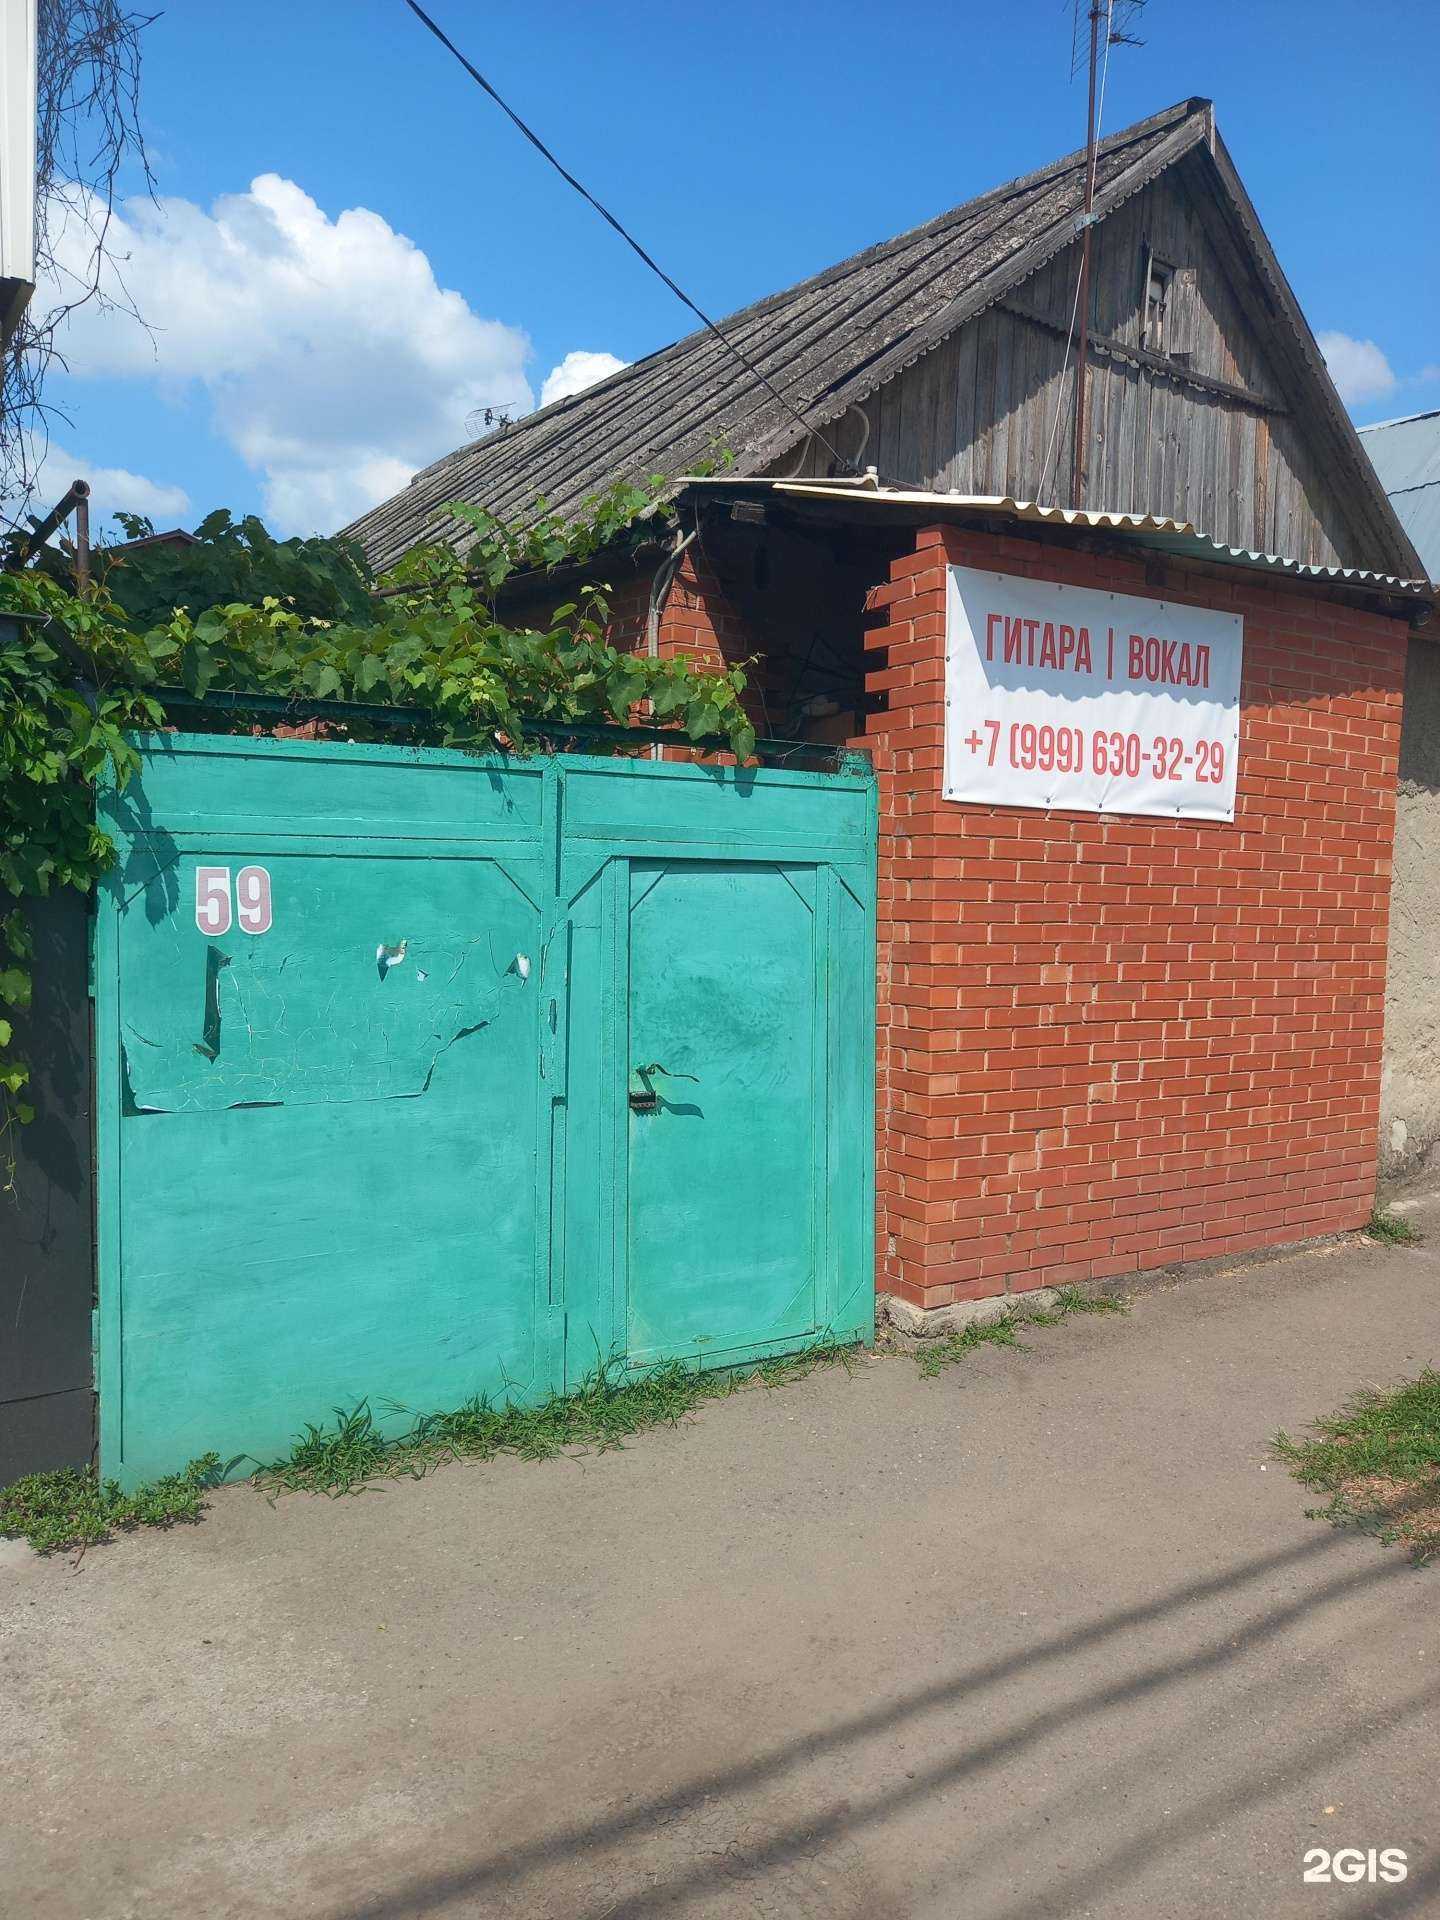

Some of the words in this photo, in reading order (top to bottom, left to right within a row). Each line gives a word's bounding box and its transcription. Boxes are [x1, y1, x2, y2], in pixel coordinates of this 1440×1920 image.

[985, 613, 1093, 674] ГИТАРА
[1127, 634, 1211, 689] ВОКАЛ
[964, 719, 1001, 767] +7
[1009, 722, 1084, 773] (999)
[1092, 730, 1225, 784] 630-32-29
[196, 866, 272, 935] 59
